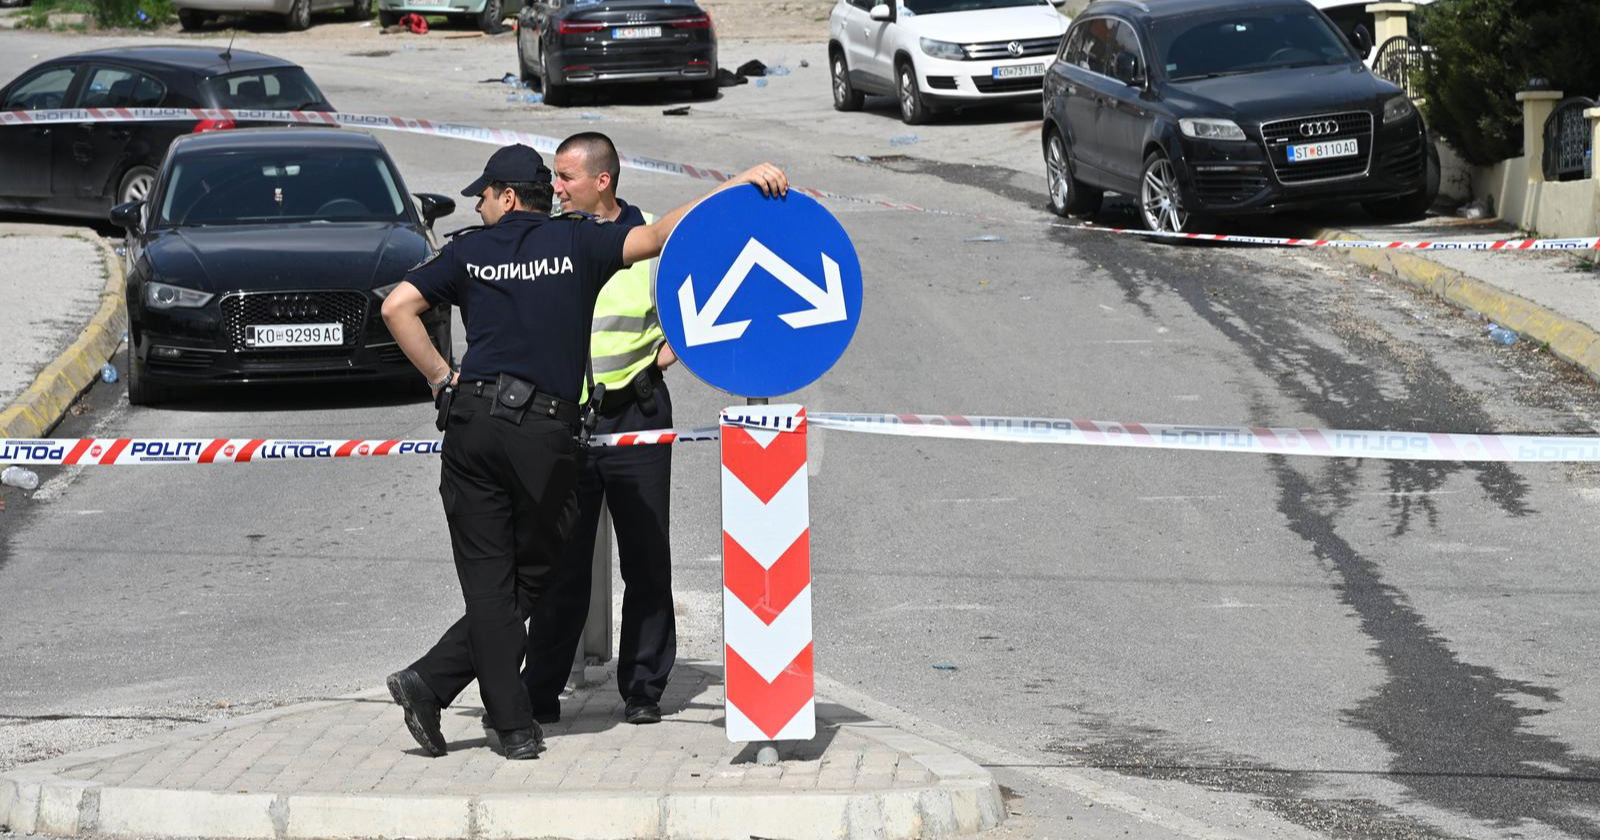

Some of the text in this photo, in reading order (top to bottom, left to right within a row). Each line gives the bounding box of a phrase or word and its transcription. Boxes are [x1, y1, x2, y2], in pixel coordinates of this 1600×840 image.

[1295, 141, 1356, 159] ST 8110 AD
[466, 256, 574, 281] ПОЛИЦИЈА
[257, 327, 341, 344] KO 9299 AC
[0, 446, 64, 460] POLIT
[131, 442, 202, 456] POLITI
[261, 444, 332, 459] POLITI
[399, 442, 442, 454] POL
